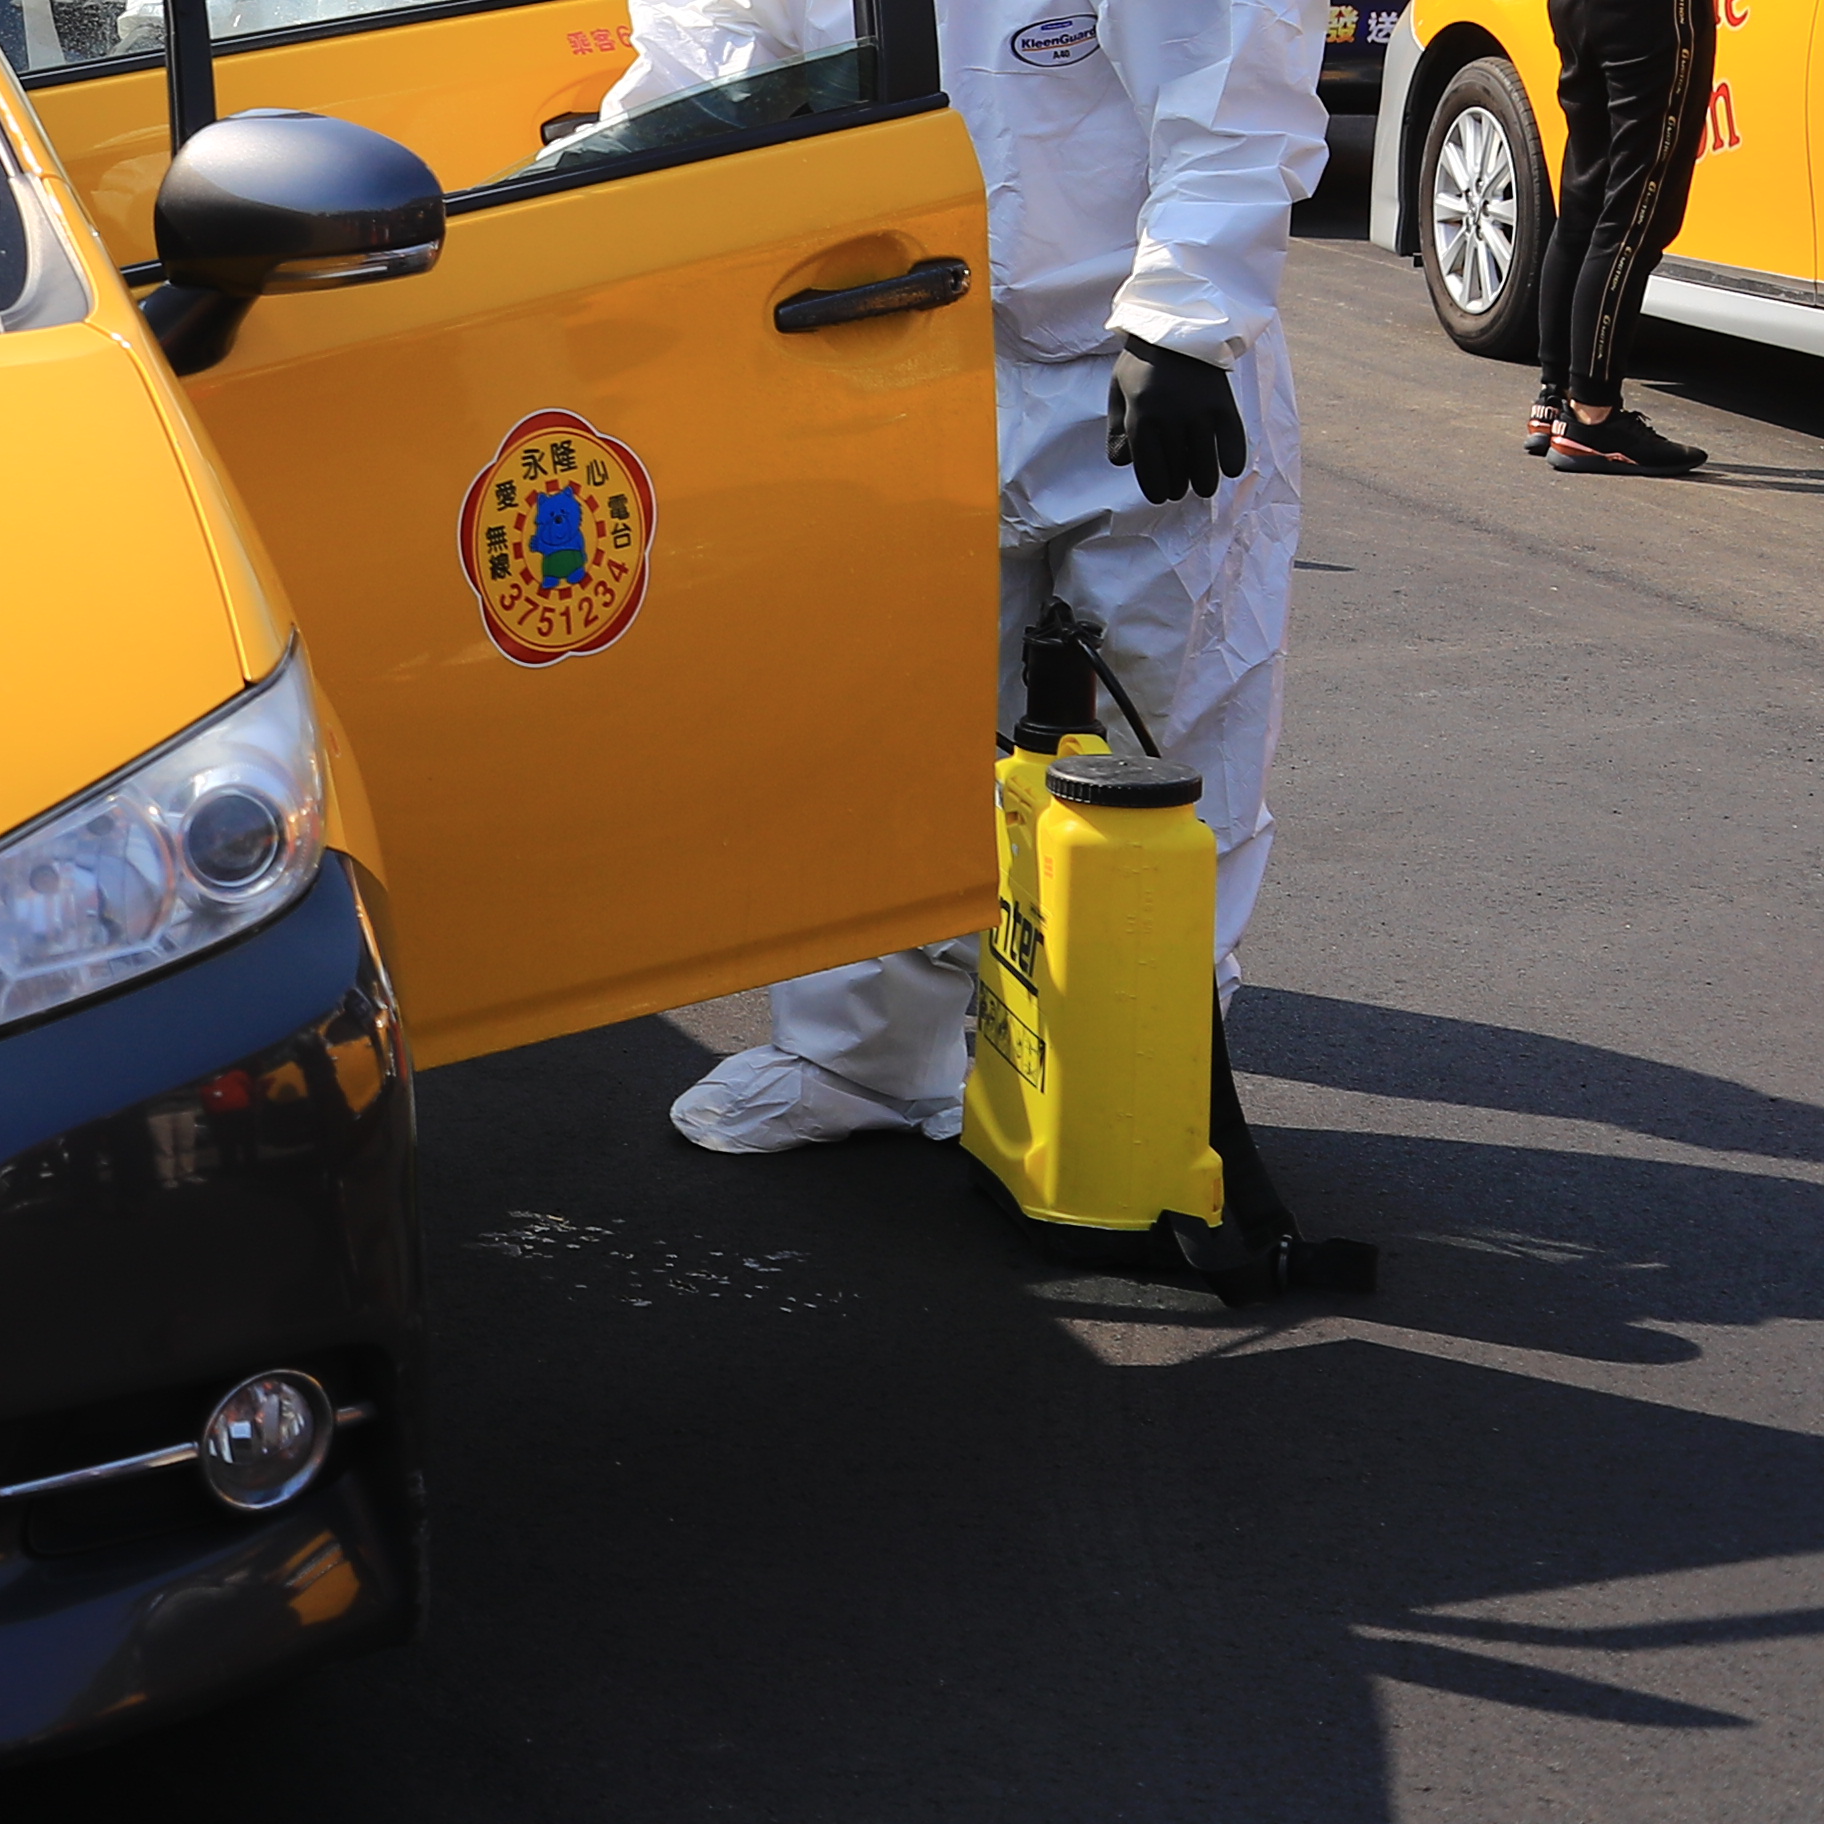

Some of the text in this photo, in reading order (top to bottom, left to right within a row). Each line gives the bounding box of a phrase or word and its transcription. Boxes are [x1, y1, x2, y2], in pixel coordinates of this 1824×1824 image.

[1021, 24, 1096, 49] KleenGuard
[1053, 50, 1070, 60] A40
[1367, 12, 1398, 43] 送
[495, 439, 610, 511] 愛 永隆 心
[607, 494, 632, 549] 電台
[485, 525, 512, 581] 無線
[499, 558, 630, 637] 3751234
